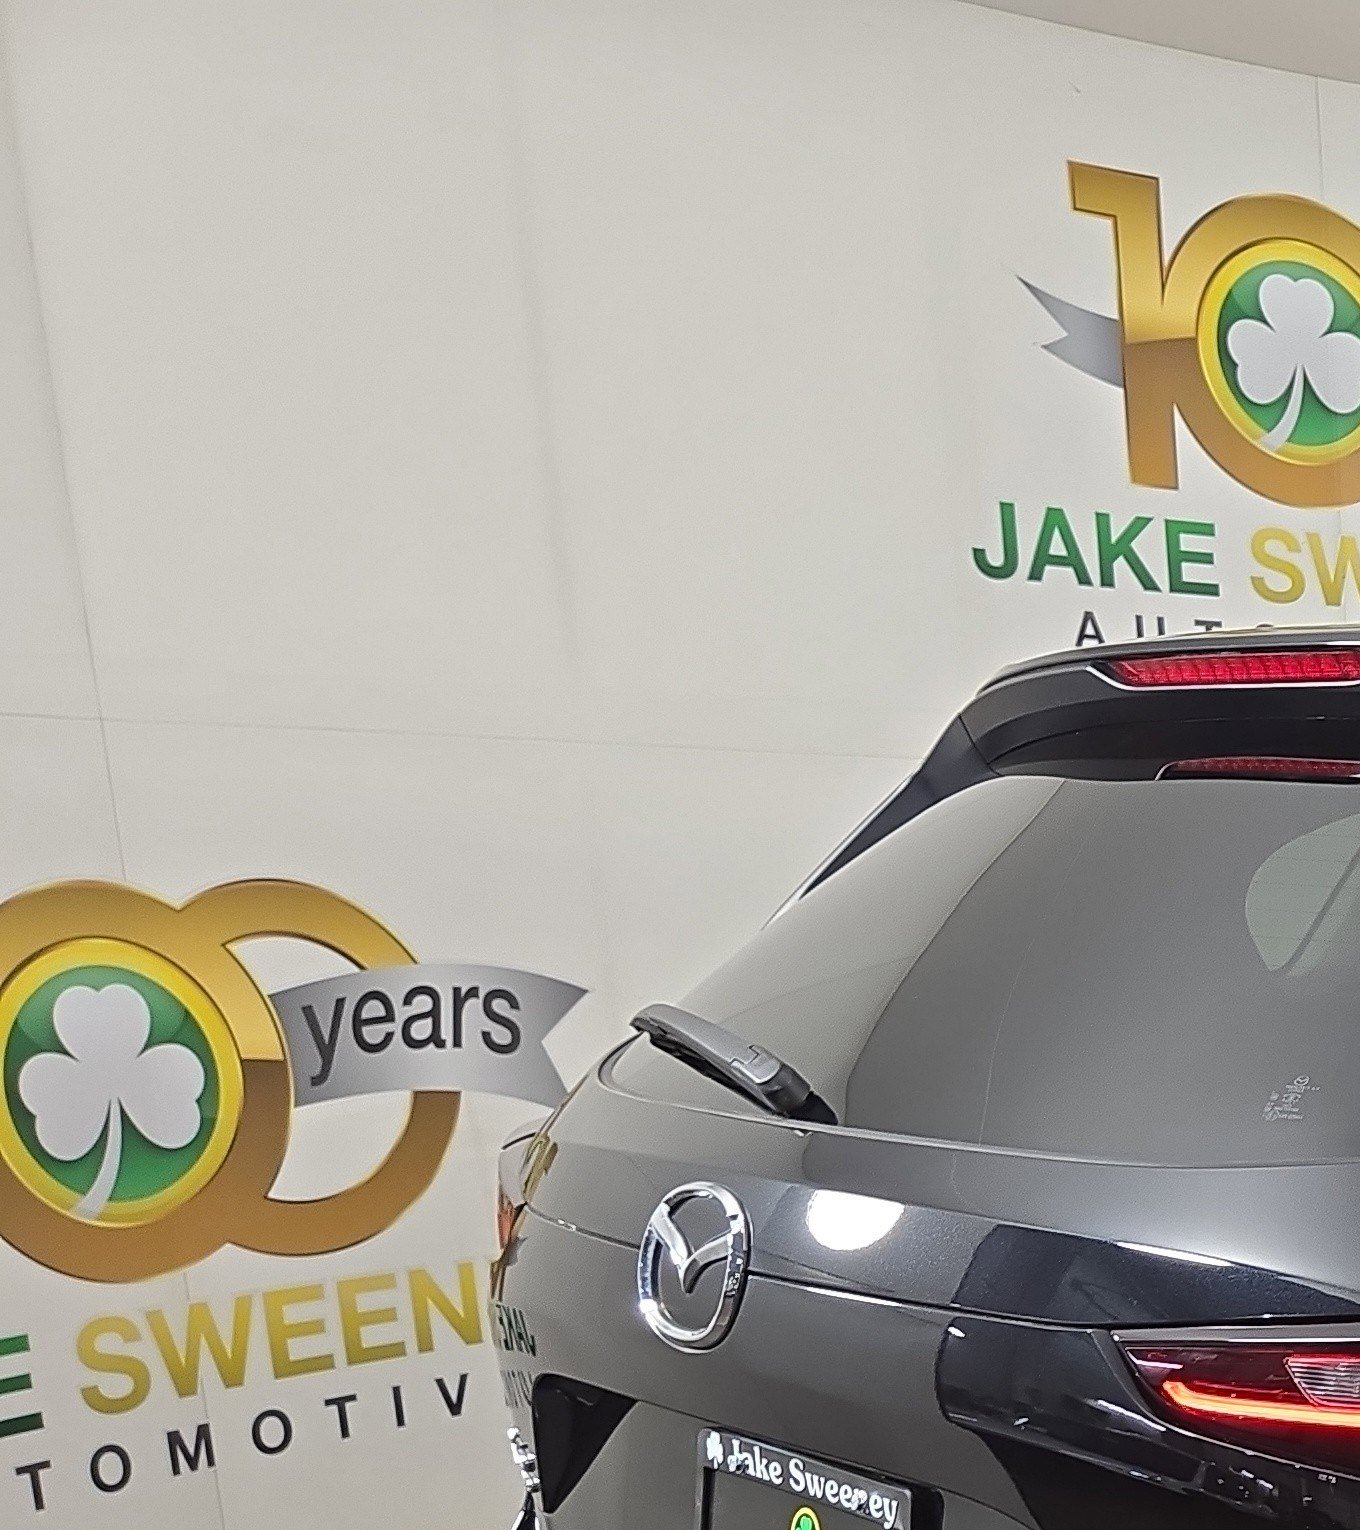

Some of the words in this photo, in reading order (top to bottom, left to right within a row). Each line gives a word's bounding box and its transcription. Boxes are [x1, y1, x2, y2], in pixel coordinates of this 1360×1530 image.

[972, 500, 1220, 597] JAKE
[301, 985, 521, 1087] years
[76, 1262, 483, 1415] SWEEN
[15, 1372, 468, 1511] TOMOTIV
[727, 1438, 784, 1485] Jake
[788, 1457, 898, 1530] Sweeney
